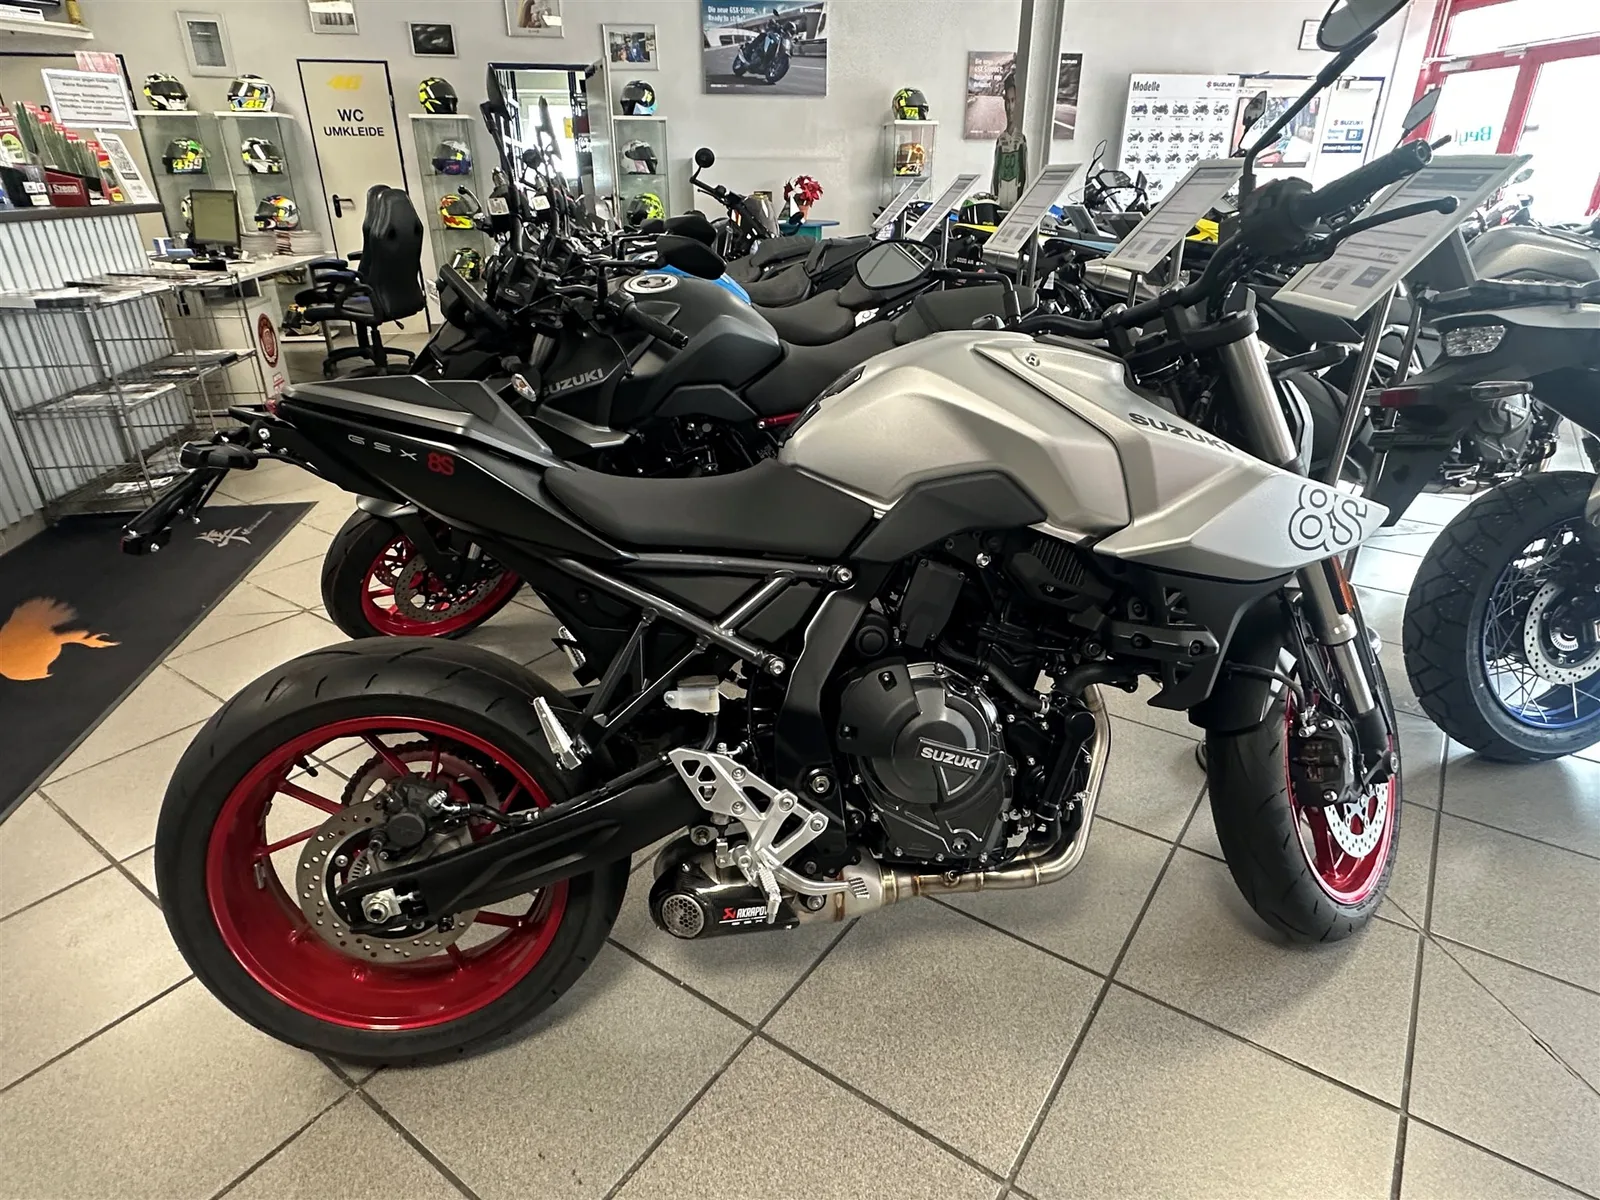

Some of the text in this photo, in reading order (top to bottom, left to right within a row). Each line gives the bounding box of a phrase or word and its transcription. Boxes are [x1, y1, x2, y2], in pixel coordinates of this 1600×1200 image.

[1132, 81, 1160, 91] Modelle
[337, 108, 364, 122] WC
[323, 126, 385, 137] UMKLEIDE
[1128, 412, 1234, 453] SUZUKI
[347, 434, 455, 476] GSX 8S
[1288, 484, 1368, 552] 8S
[920, 746, 981, 770] SUZUKI
